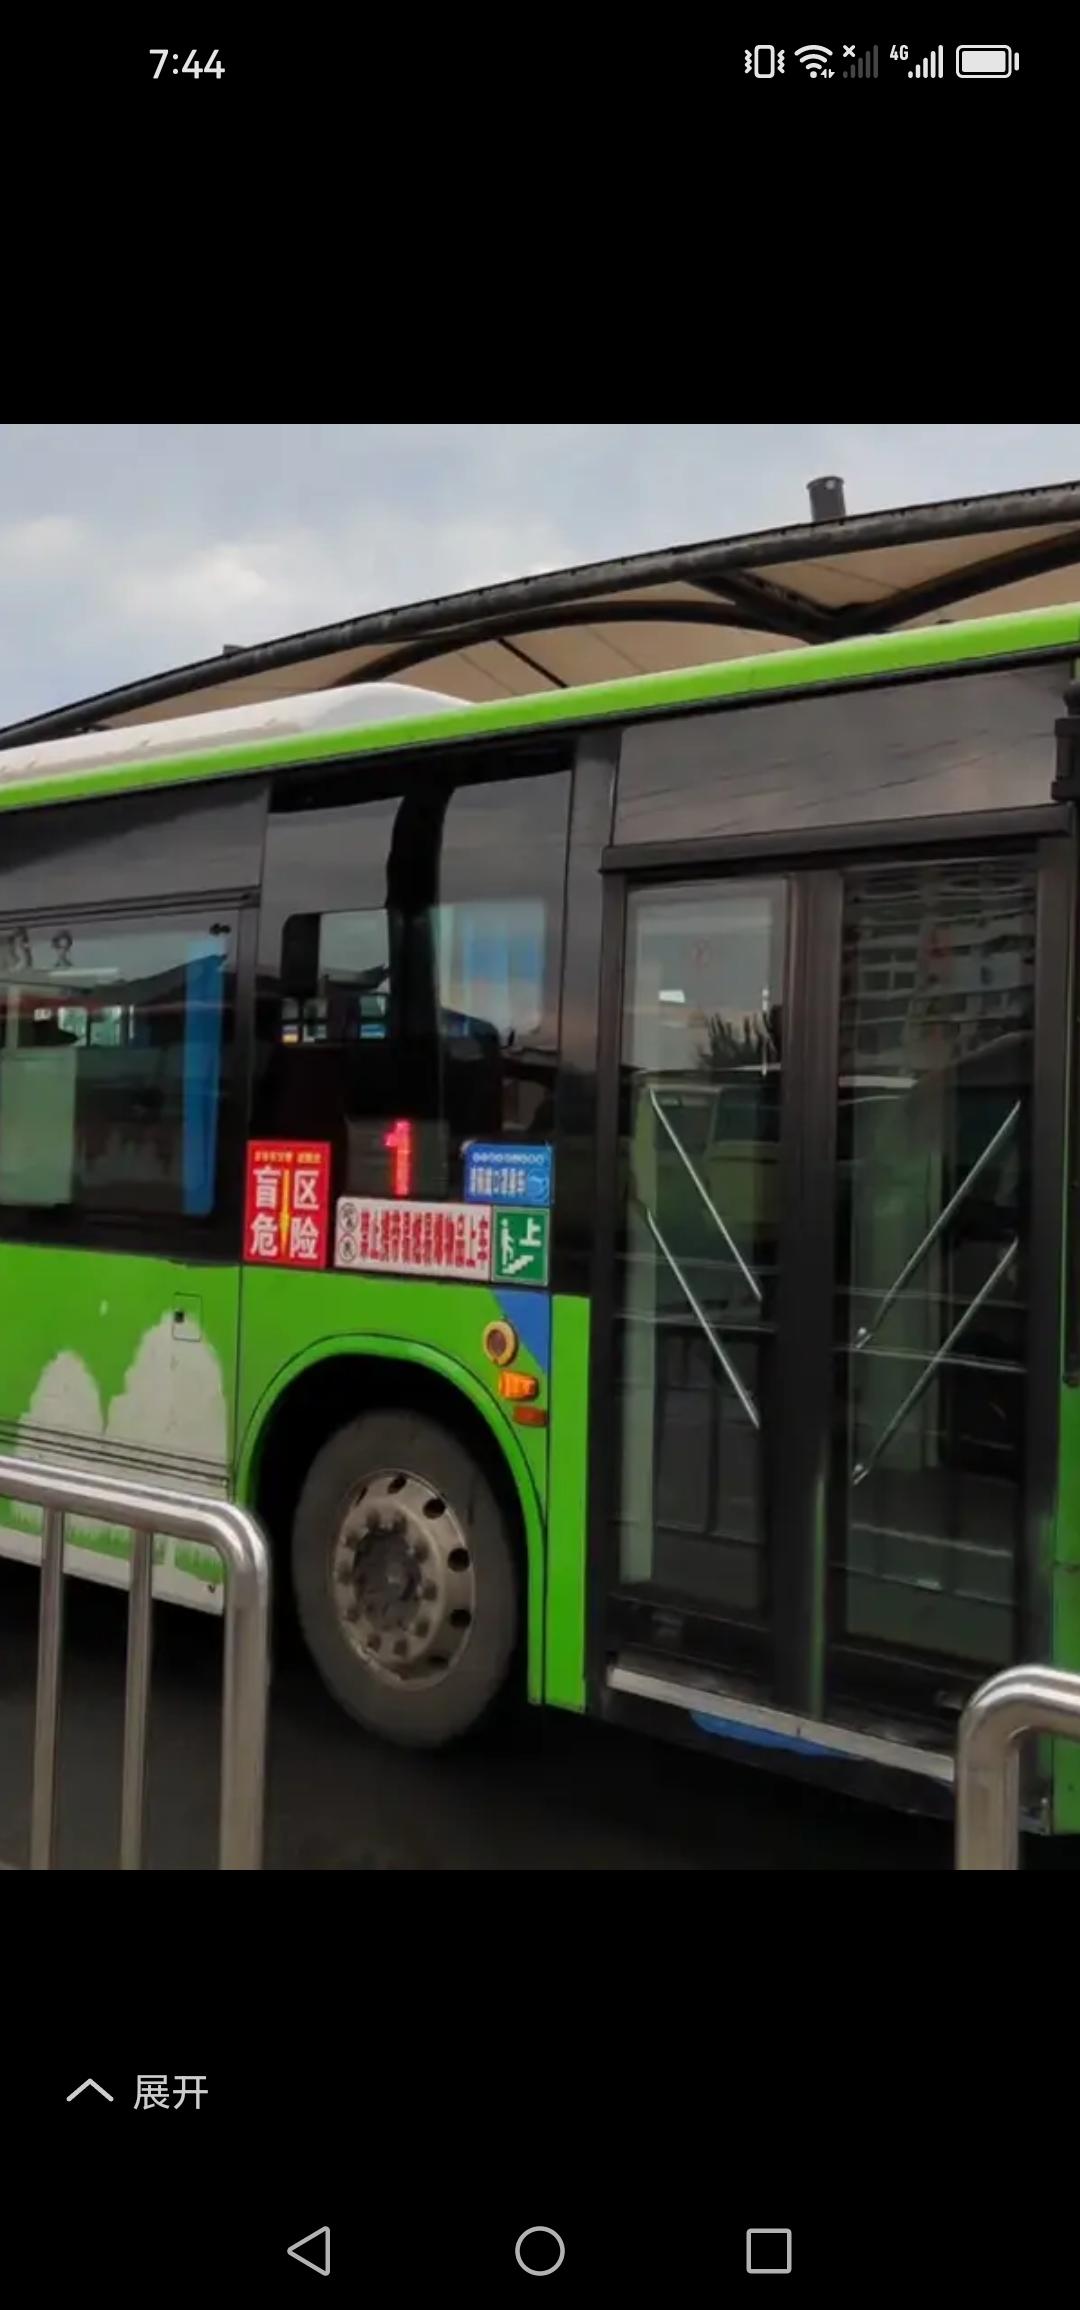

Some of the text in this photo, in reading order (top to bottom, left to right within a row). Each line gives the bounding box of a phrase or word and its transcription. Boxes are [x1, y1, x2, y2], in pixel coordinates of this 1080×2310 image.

[384, 1119, 410, 1196] 1
[252, 1165, 320, 1210] 盲区
[250, 1213, 320, 1259] 危险
[519, 1217, 542, 1247] 上
